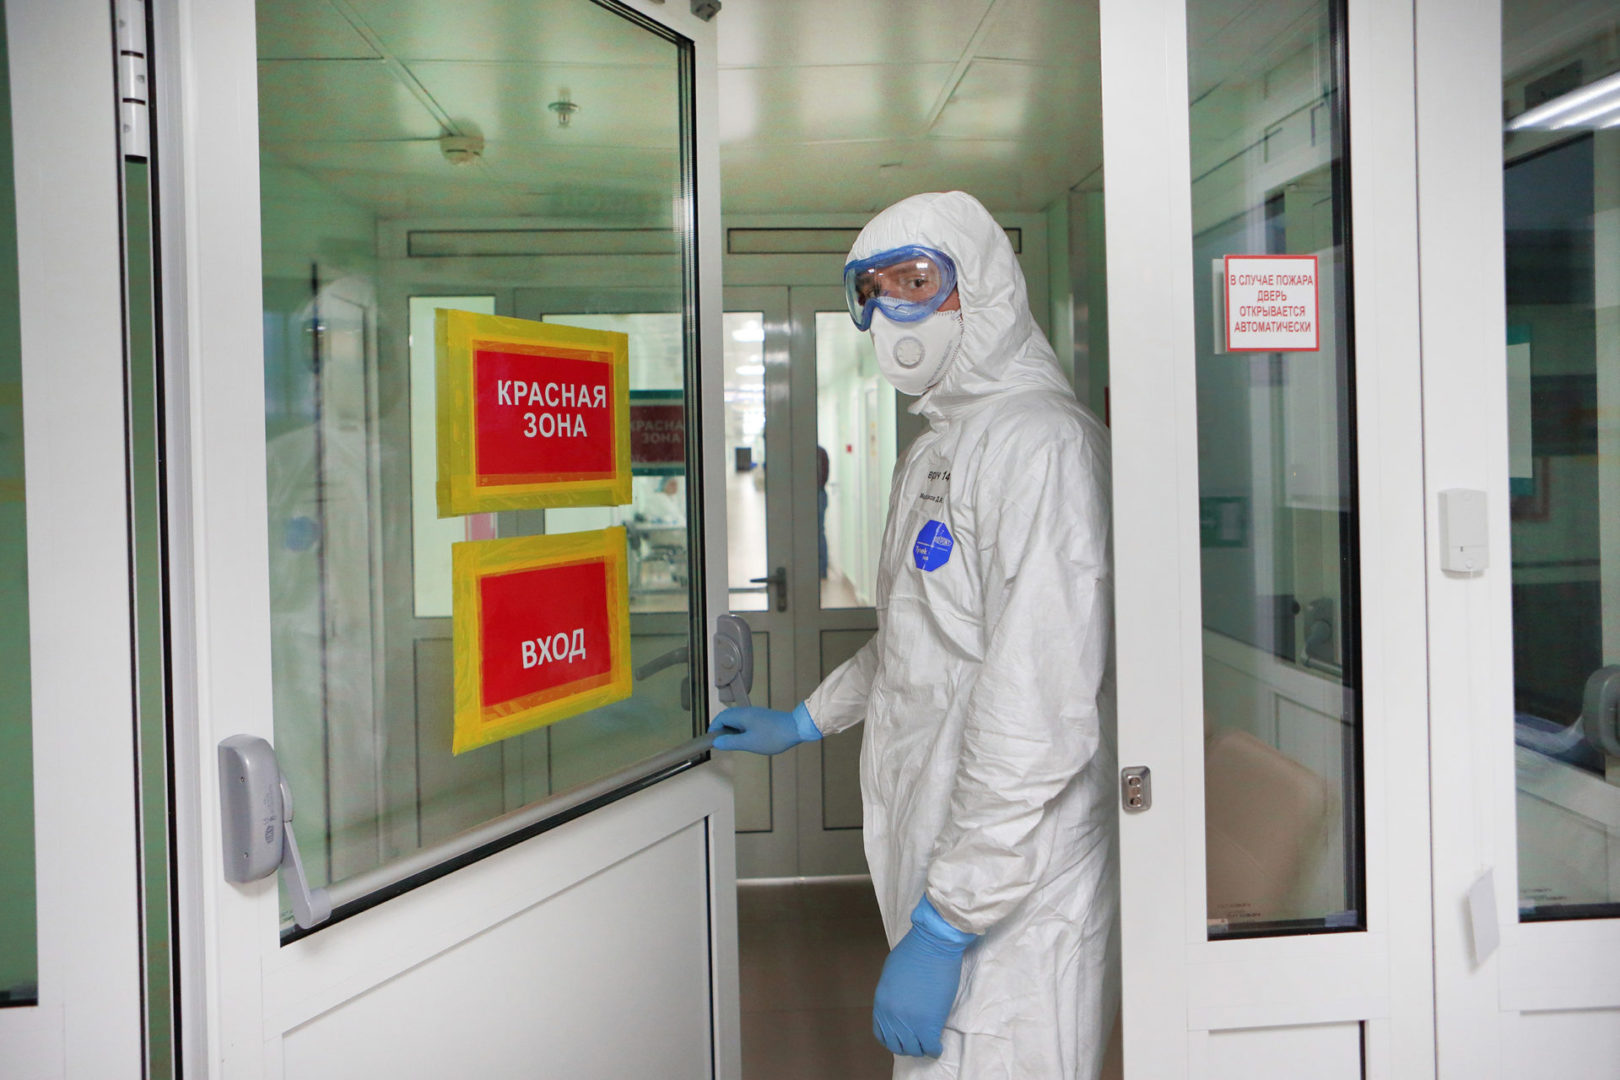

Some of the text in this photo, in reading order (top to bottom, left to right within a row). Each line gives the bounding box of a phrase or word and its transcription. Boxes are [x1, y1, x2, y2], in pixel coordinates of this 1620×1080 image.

[1230, 274, 1314, 286] В СЛУЧАЕ ПОЖАРА
[1256, 290, 1288, 303] ДВЕРЬ
[1239, 305, 1306, 317] ОТКРЫВАЕТСЯ
[1234, 321, 1312, 333] АВТОМАТИЧЕСКИ
[497, 379, 607, 409] КРАСНАЯ
[523, 412, 588, 438] ЗОНА
[630, 419, 684, 432] КРАСНА
[641, 432, 681, 444] ЗОНА
[521, 627, 587, 670] ВХОД
